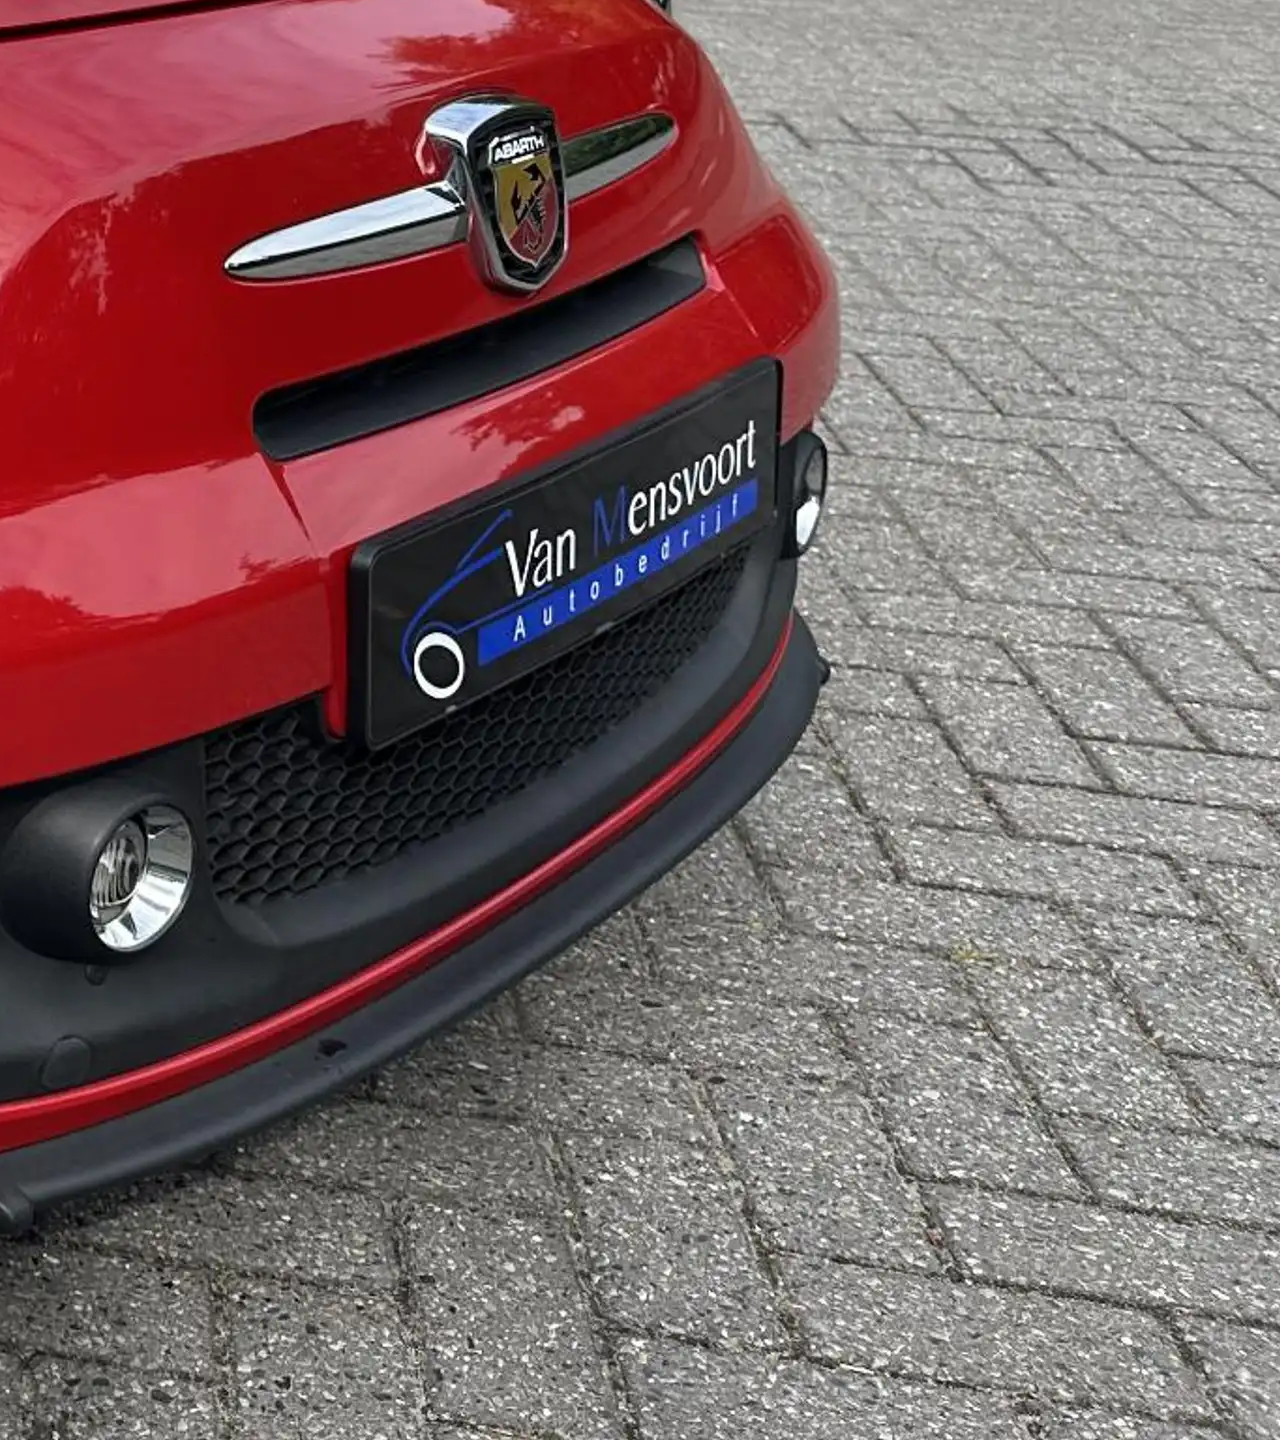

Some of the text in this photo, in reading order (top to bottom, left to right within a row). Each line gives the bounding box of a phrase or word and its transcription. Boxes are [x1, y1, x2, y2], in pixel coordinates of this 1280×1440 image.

[494, 135, 544, 162] ABARTH
[503, 418, 757, 597] Van Mensvoort
[513, 491, 740, 642] Autobedrijf
